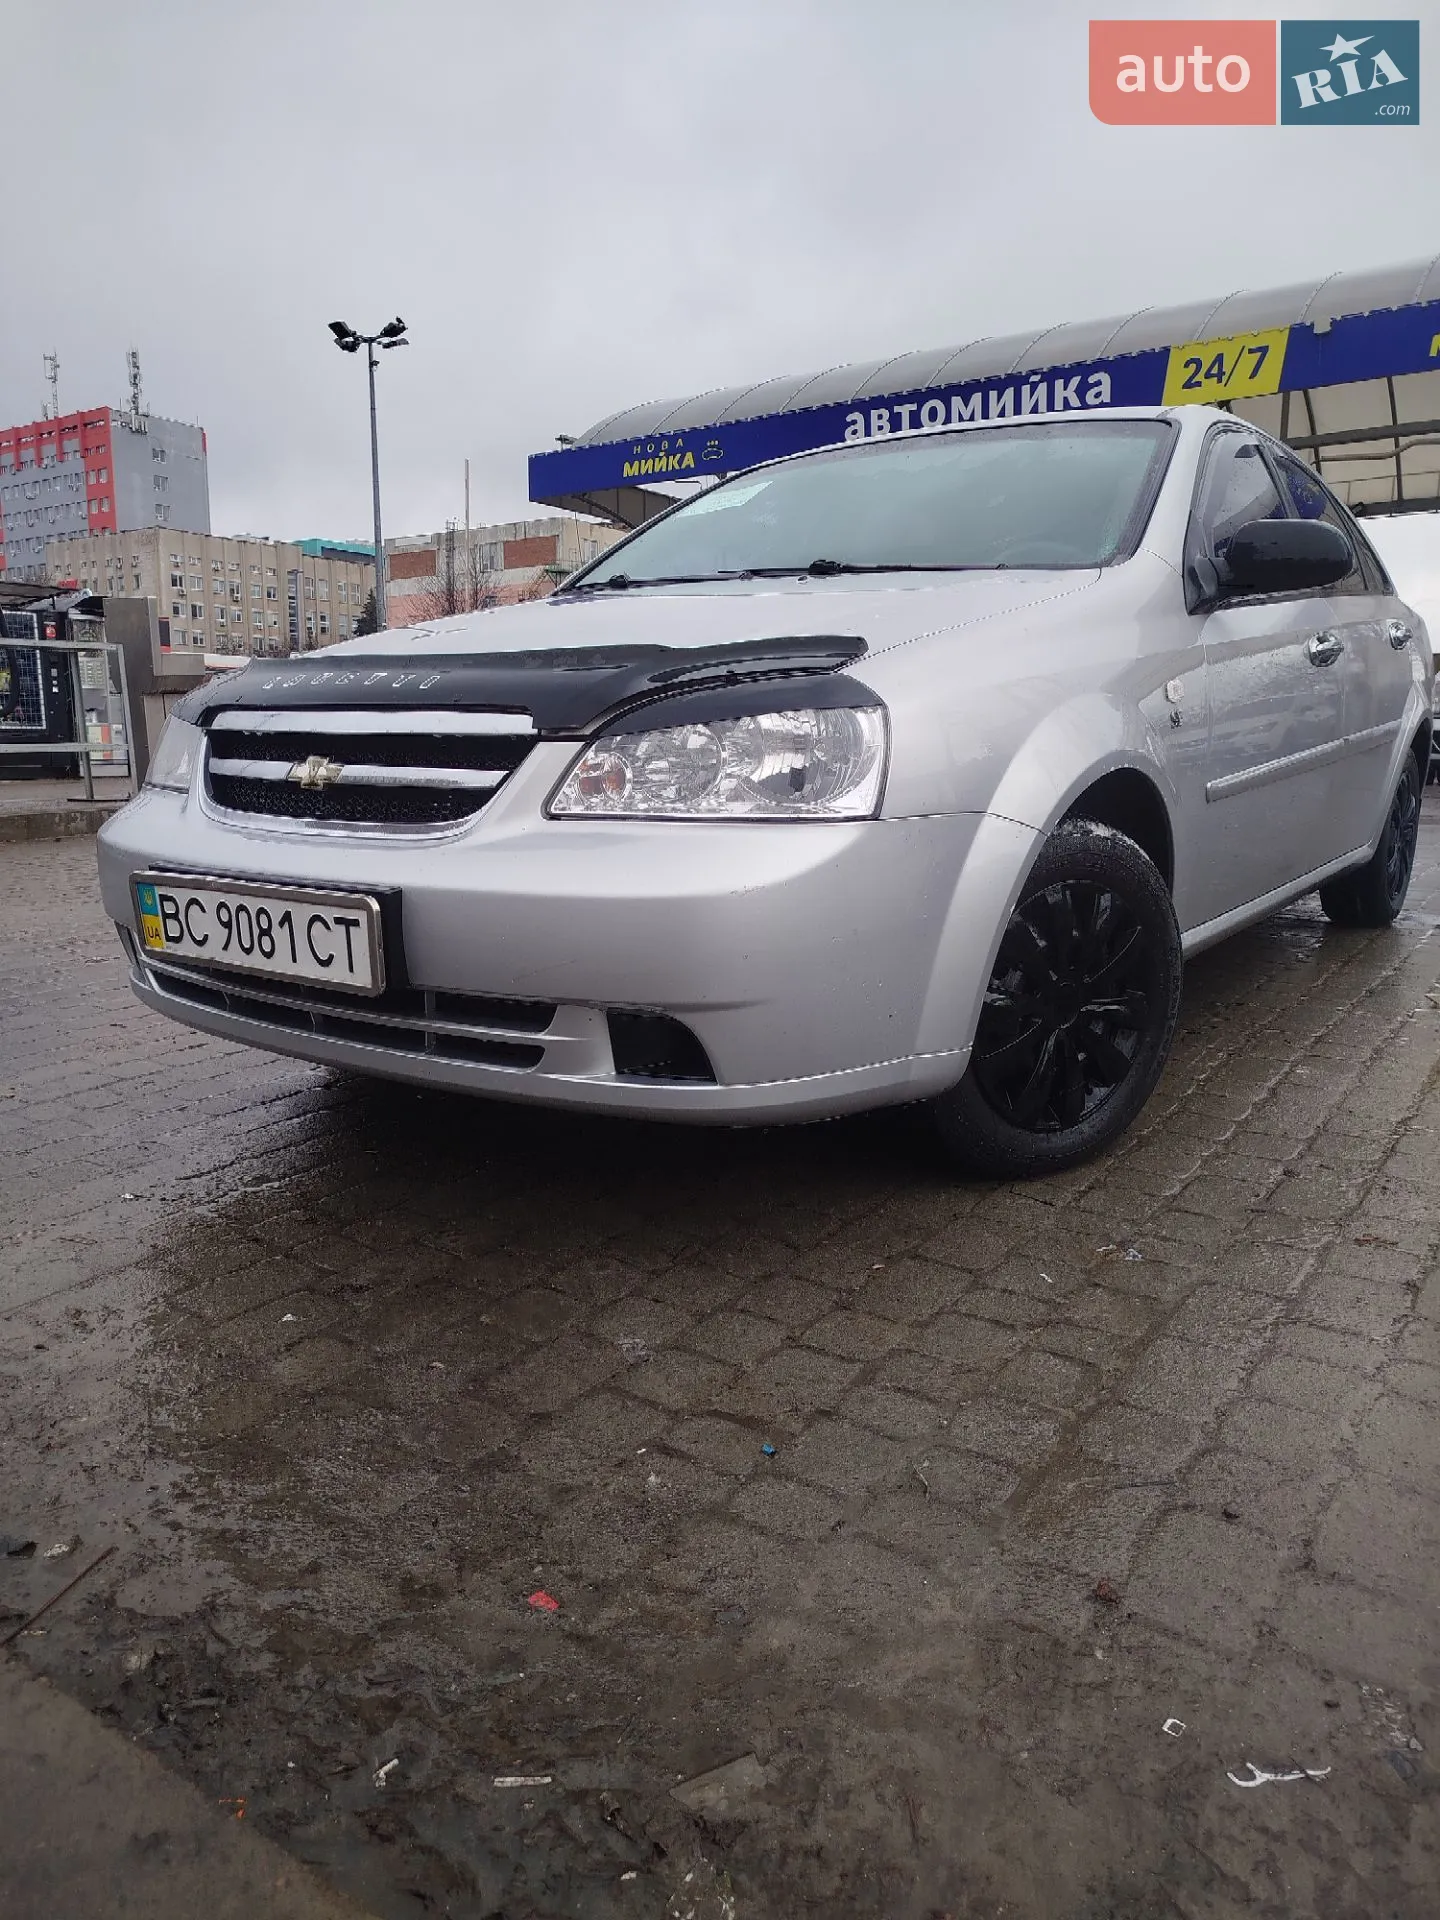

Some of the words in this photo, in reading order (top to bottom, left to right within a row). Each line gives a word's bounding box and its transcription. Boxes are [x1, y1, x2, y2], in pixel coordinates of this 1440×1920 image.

[845, 370, 1112, 440] автомийка
[1181, 345, 1270, 390] 24/7
[633, 438, 684, 455] НОВА
[622, 451, 695, 478] МИЙКА
[146, 926, 162, 941] UA
[158, 893, 209, 948] BC
[215, 900, 298, 964] 9081
[306, 913, 361, 974] CT
